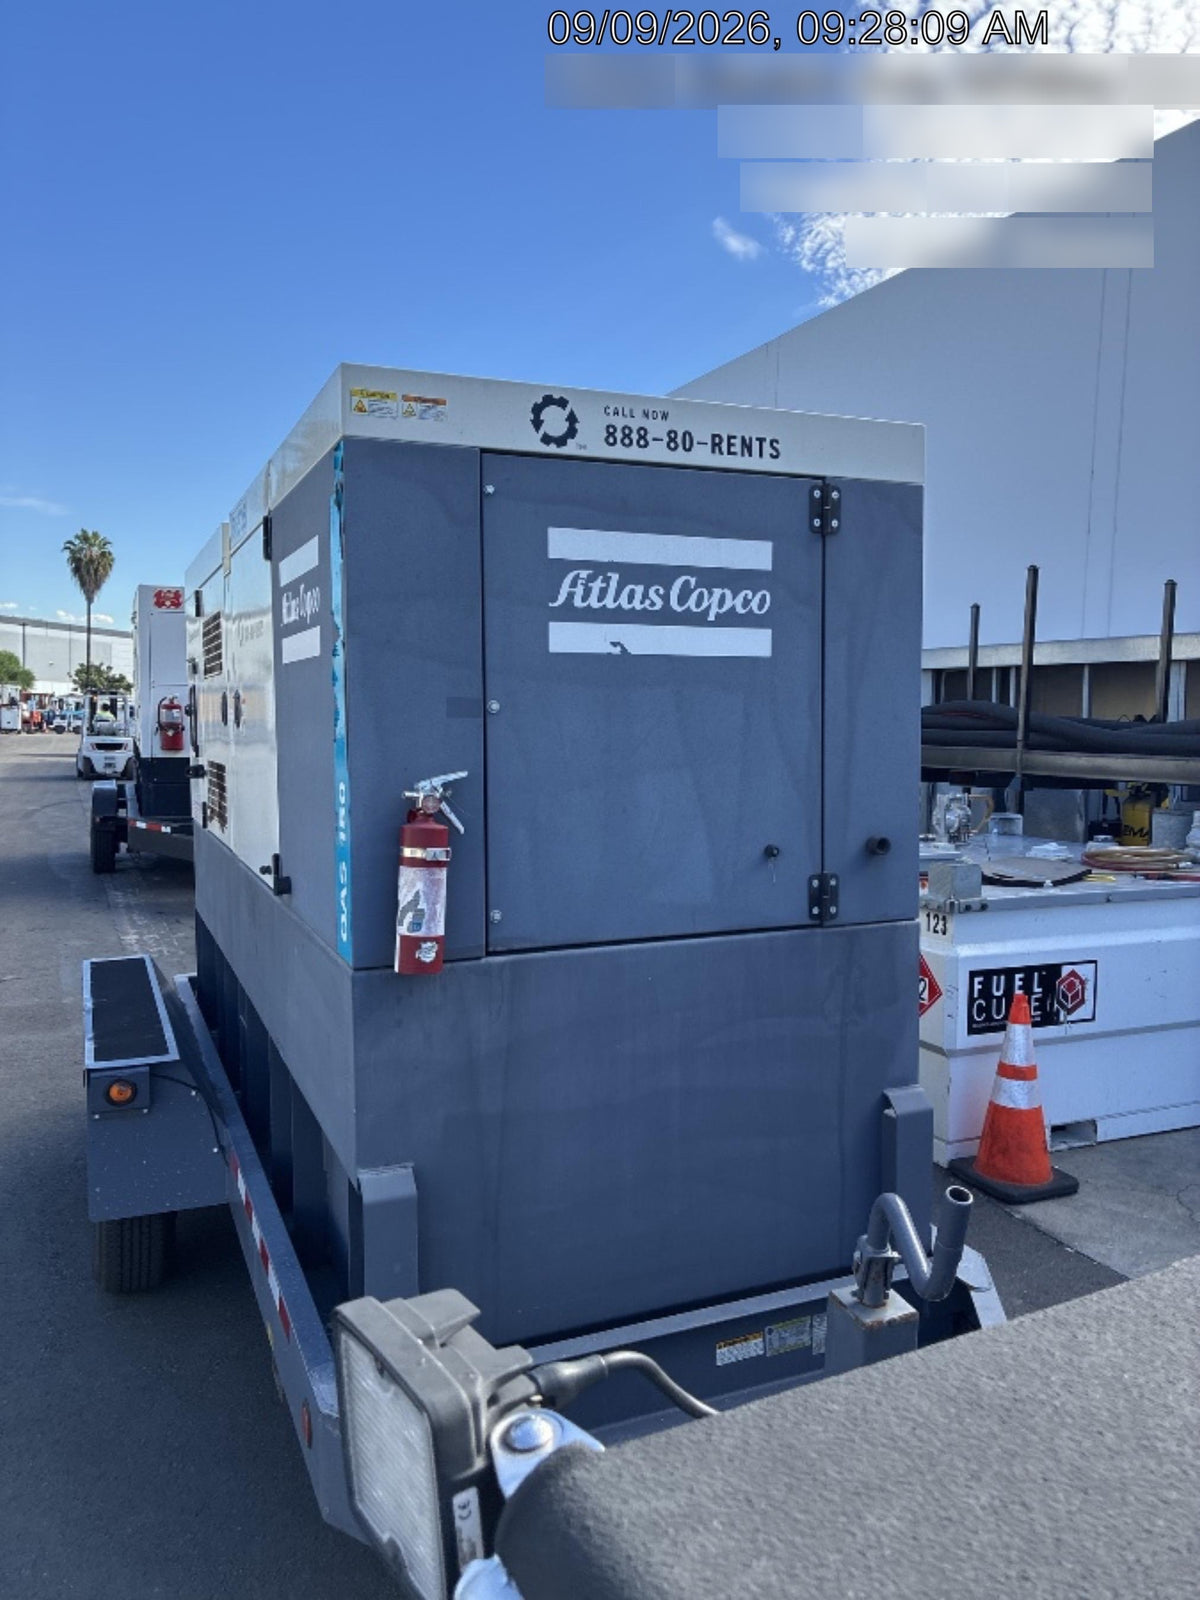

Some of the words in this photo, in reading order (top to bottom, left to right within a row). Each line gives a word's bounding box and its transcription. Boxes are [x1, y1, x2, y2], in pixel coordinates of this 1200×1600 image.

[604, 405, 636, 419] CALL
[643, 409, 670, 421] NOW
[604, 424, 781, 459] 888-80-RENTS
[549, 569, 665, 610] Atlas
[669, 575, 771, 621] Copco
[926, 911, 947, 936] 123
[973, 972, 1043, 998] FUEL
[973, 993, 1043, 1021] CUE
